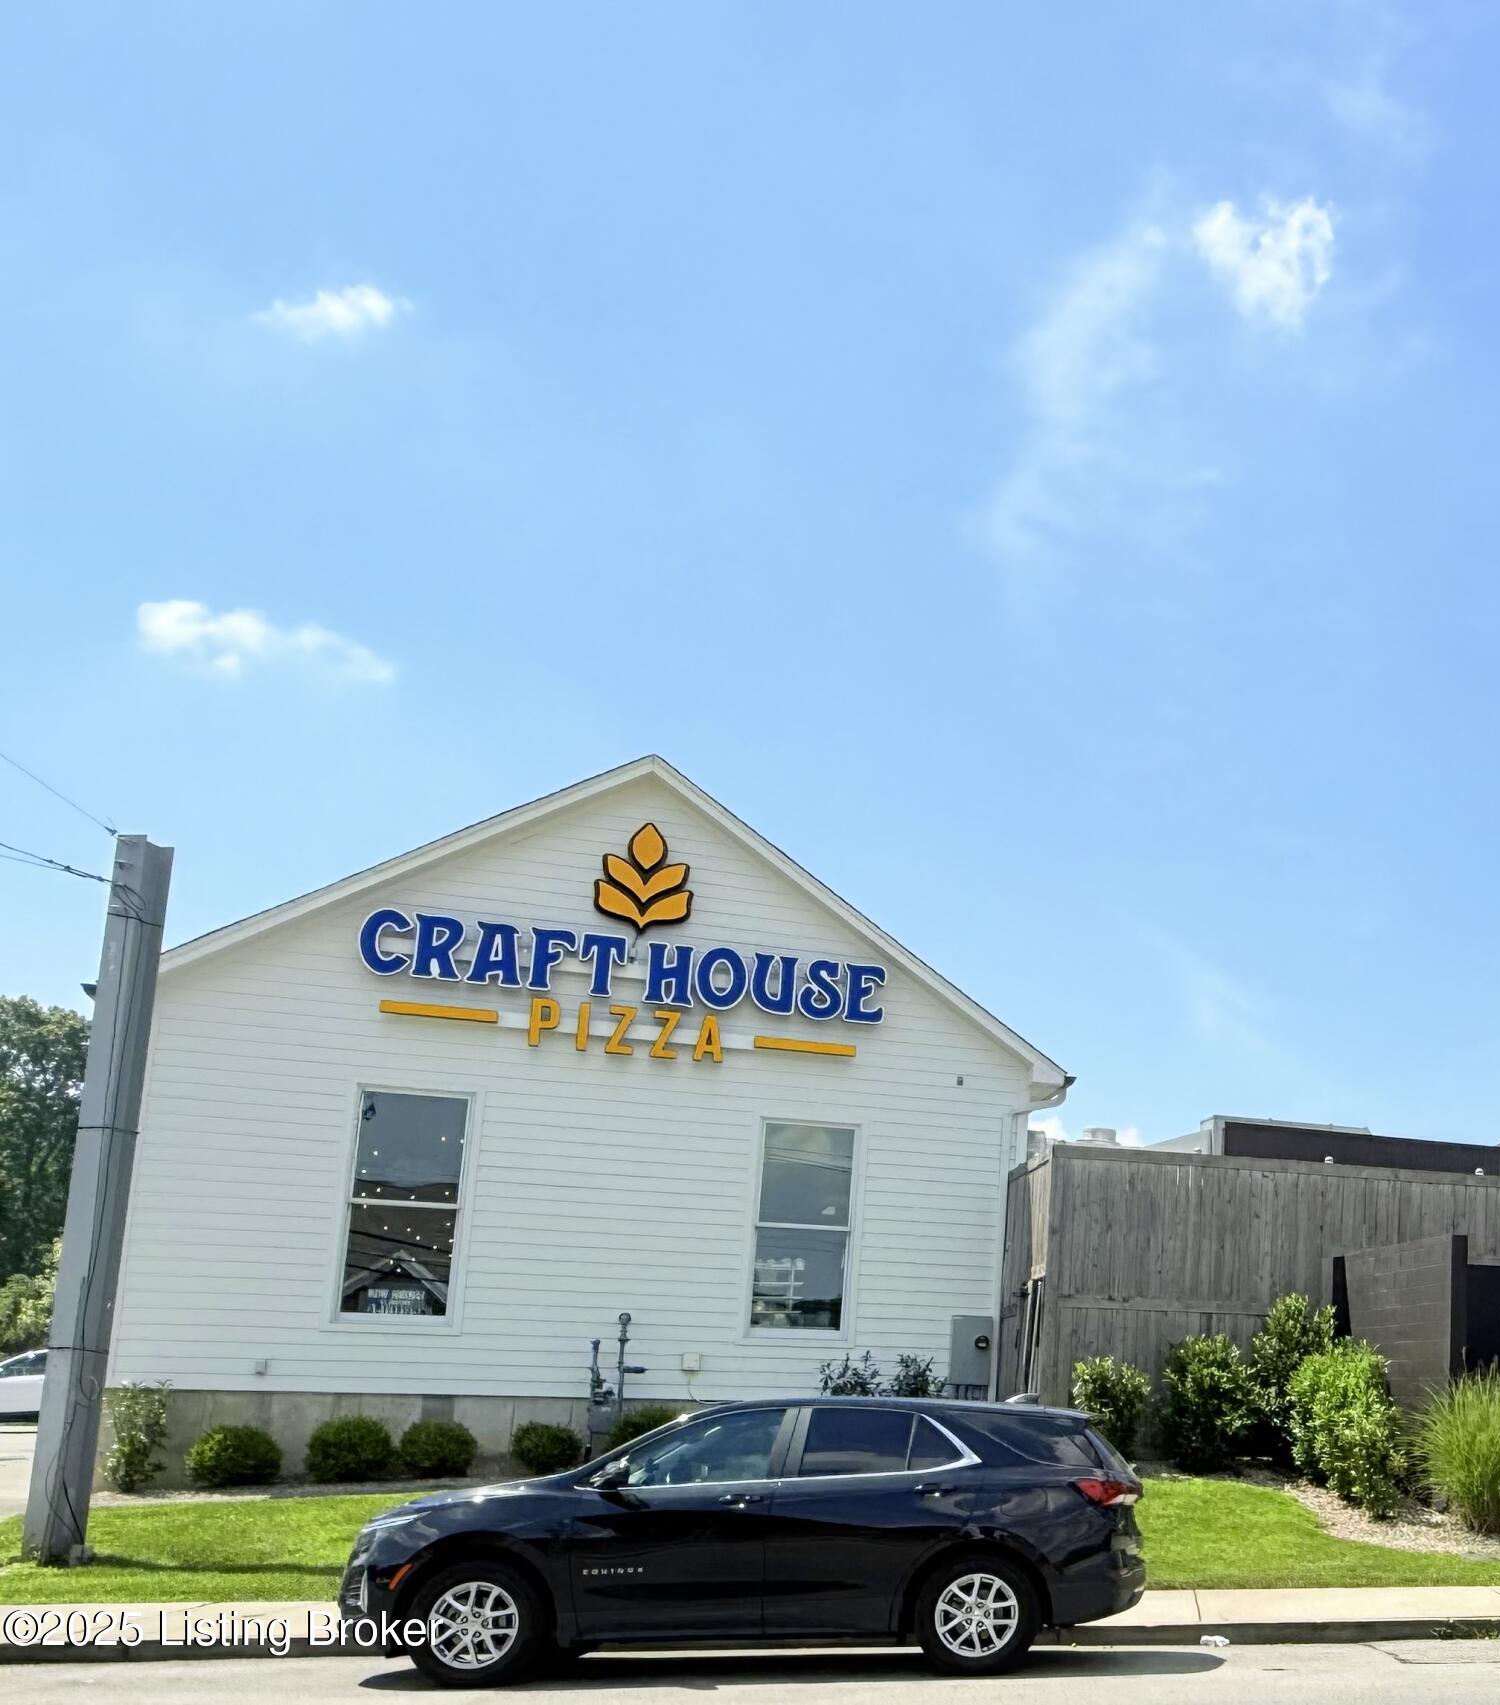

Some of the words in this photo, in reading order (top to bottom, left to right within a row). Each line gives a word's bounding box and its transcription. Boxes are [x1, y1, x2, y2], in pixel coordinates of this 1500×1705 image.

[358, 907, 627, 998] CRAFT
[642, 941, 887, 1025] HOUSE
[527, 996, 724, 1063] PIZZA
